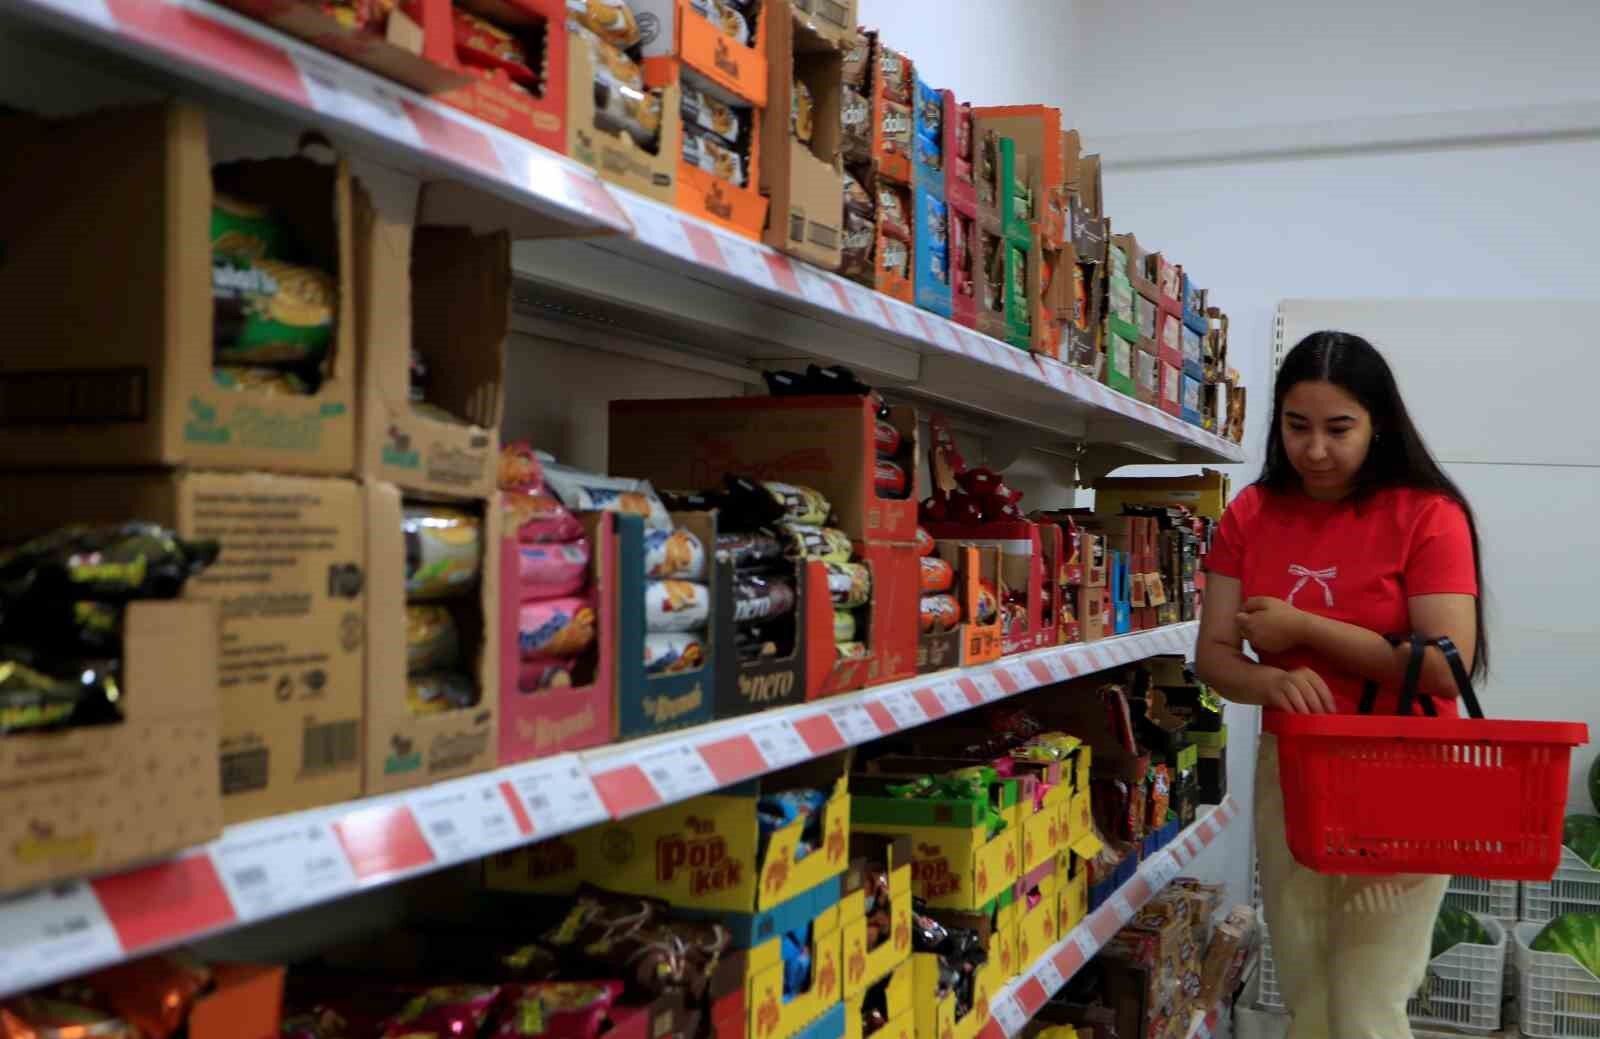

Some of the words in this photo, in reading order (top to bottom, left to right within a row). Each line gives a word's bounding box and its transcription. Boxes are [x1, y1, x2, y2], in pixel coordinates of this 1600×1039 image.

[750, 670, 794, 703] nero
[656, 836, 726, 881] pop
[689, 859, 742, 896] kek
